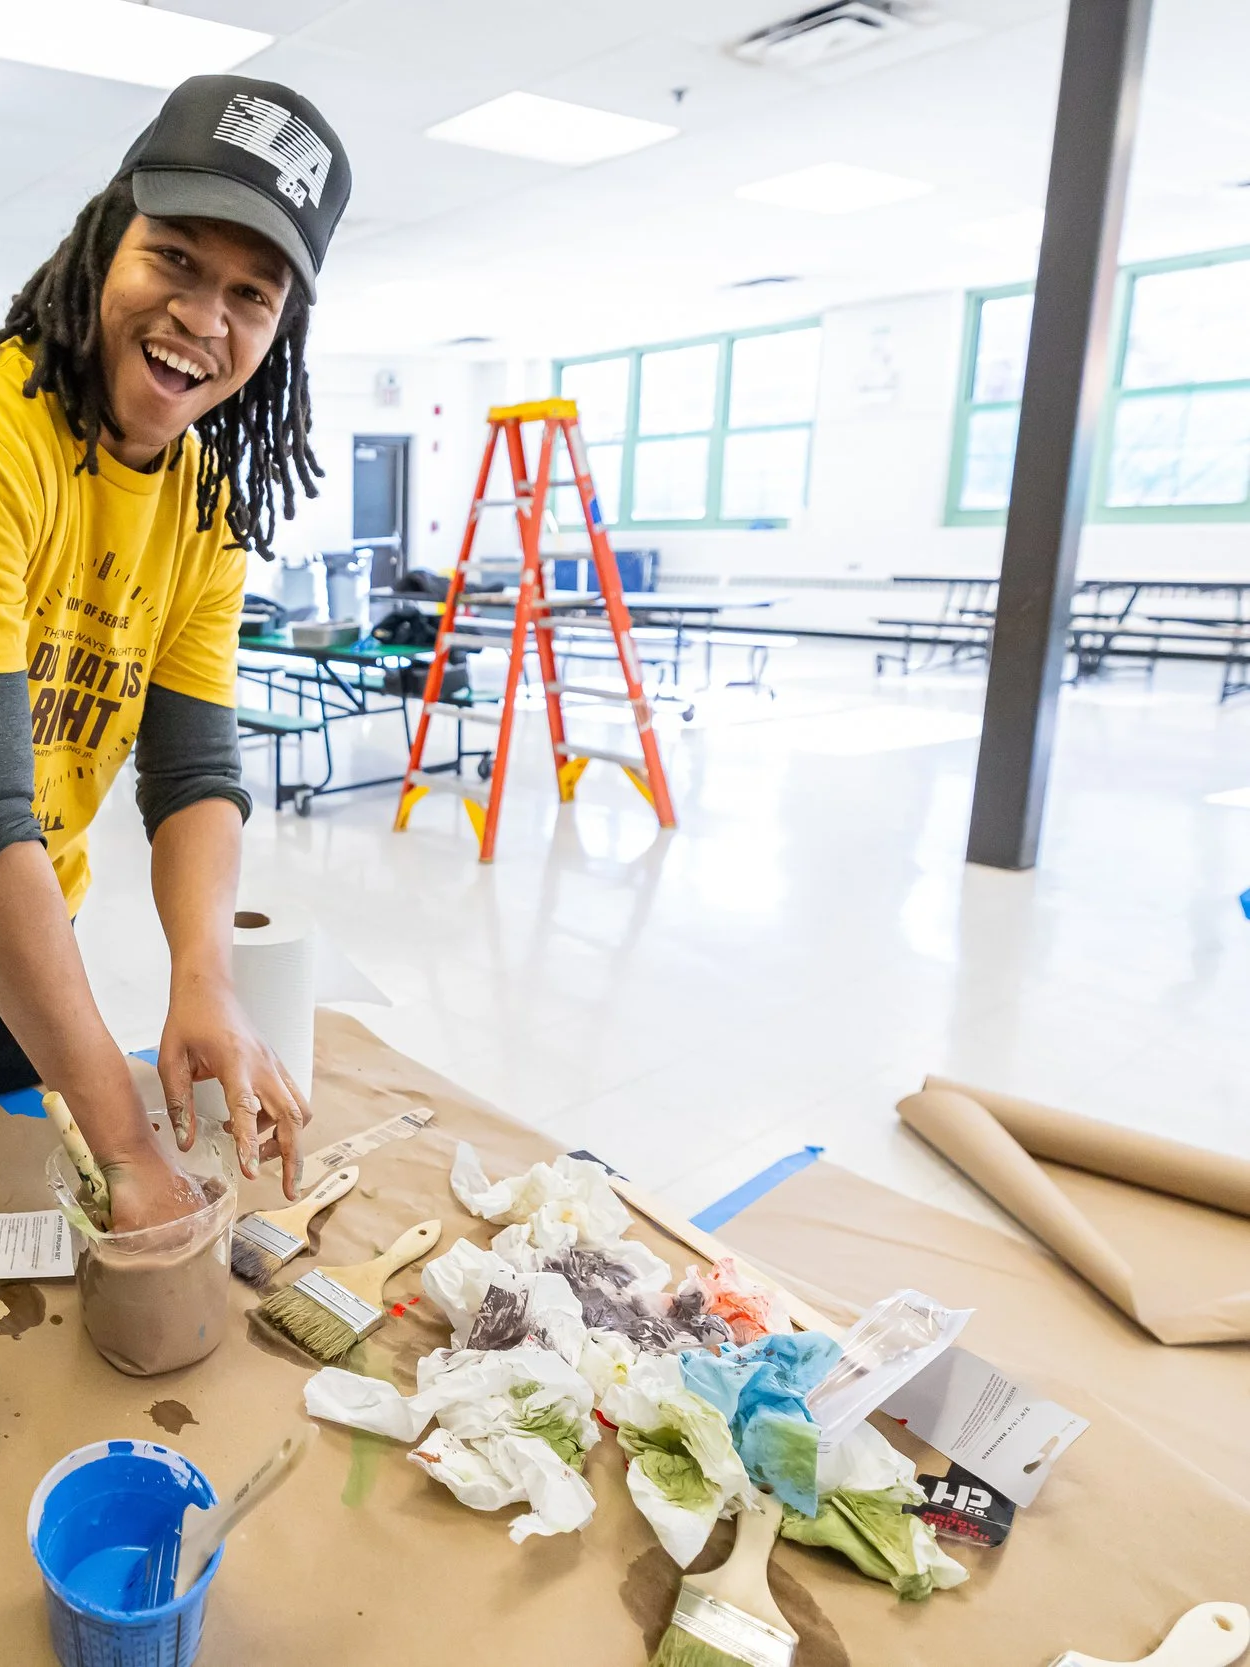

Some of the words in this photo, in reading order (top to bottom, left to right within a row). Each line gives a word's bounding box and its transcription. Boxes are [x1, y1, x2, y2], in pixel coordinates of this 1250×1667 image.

[83, 602, 98, 617] OF
[135, 647, 147, 658] TO
[119, 661, 143, 698] IS
[31, 687, 122, 750] RIHT
[981, 1432, 1008, 1460] BRUSHES
